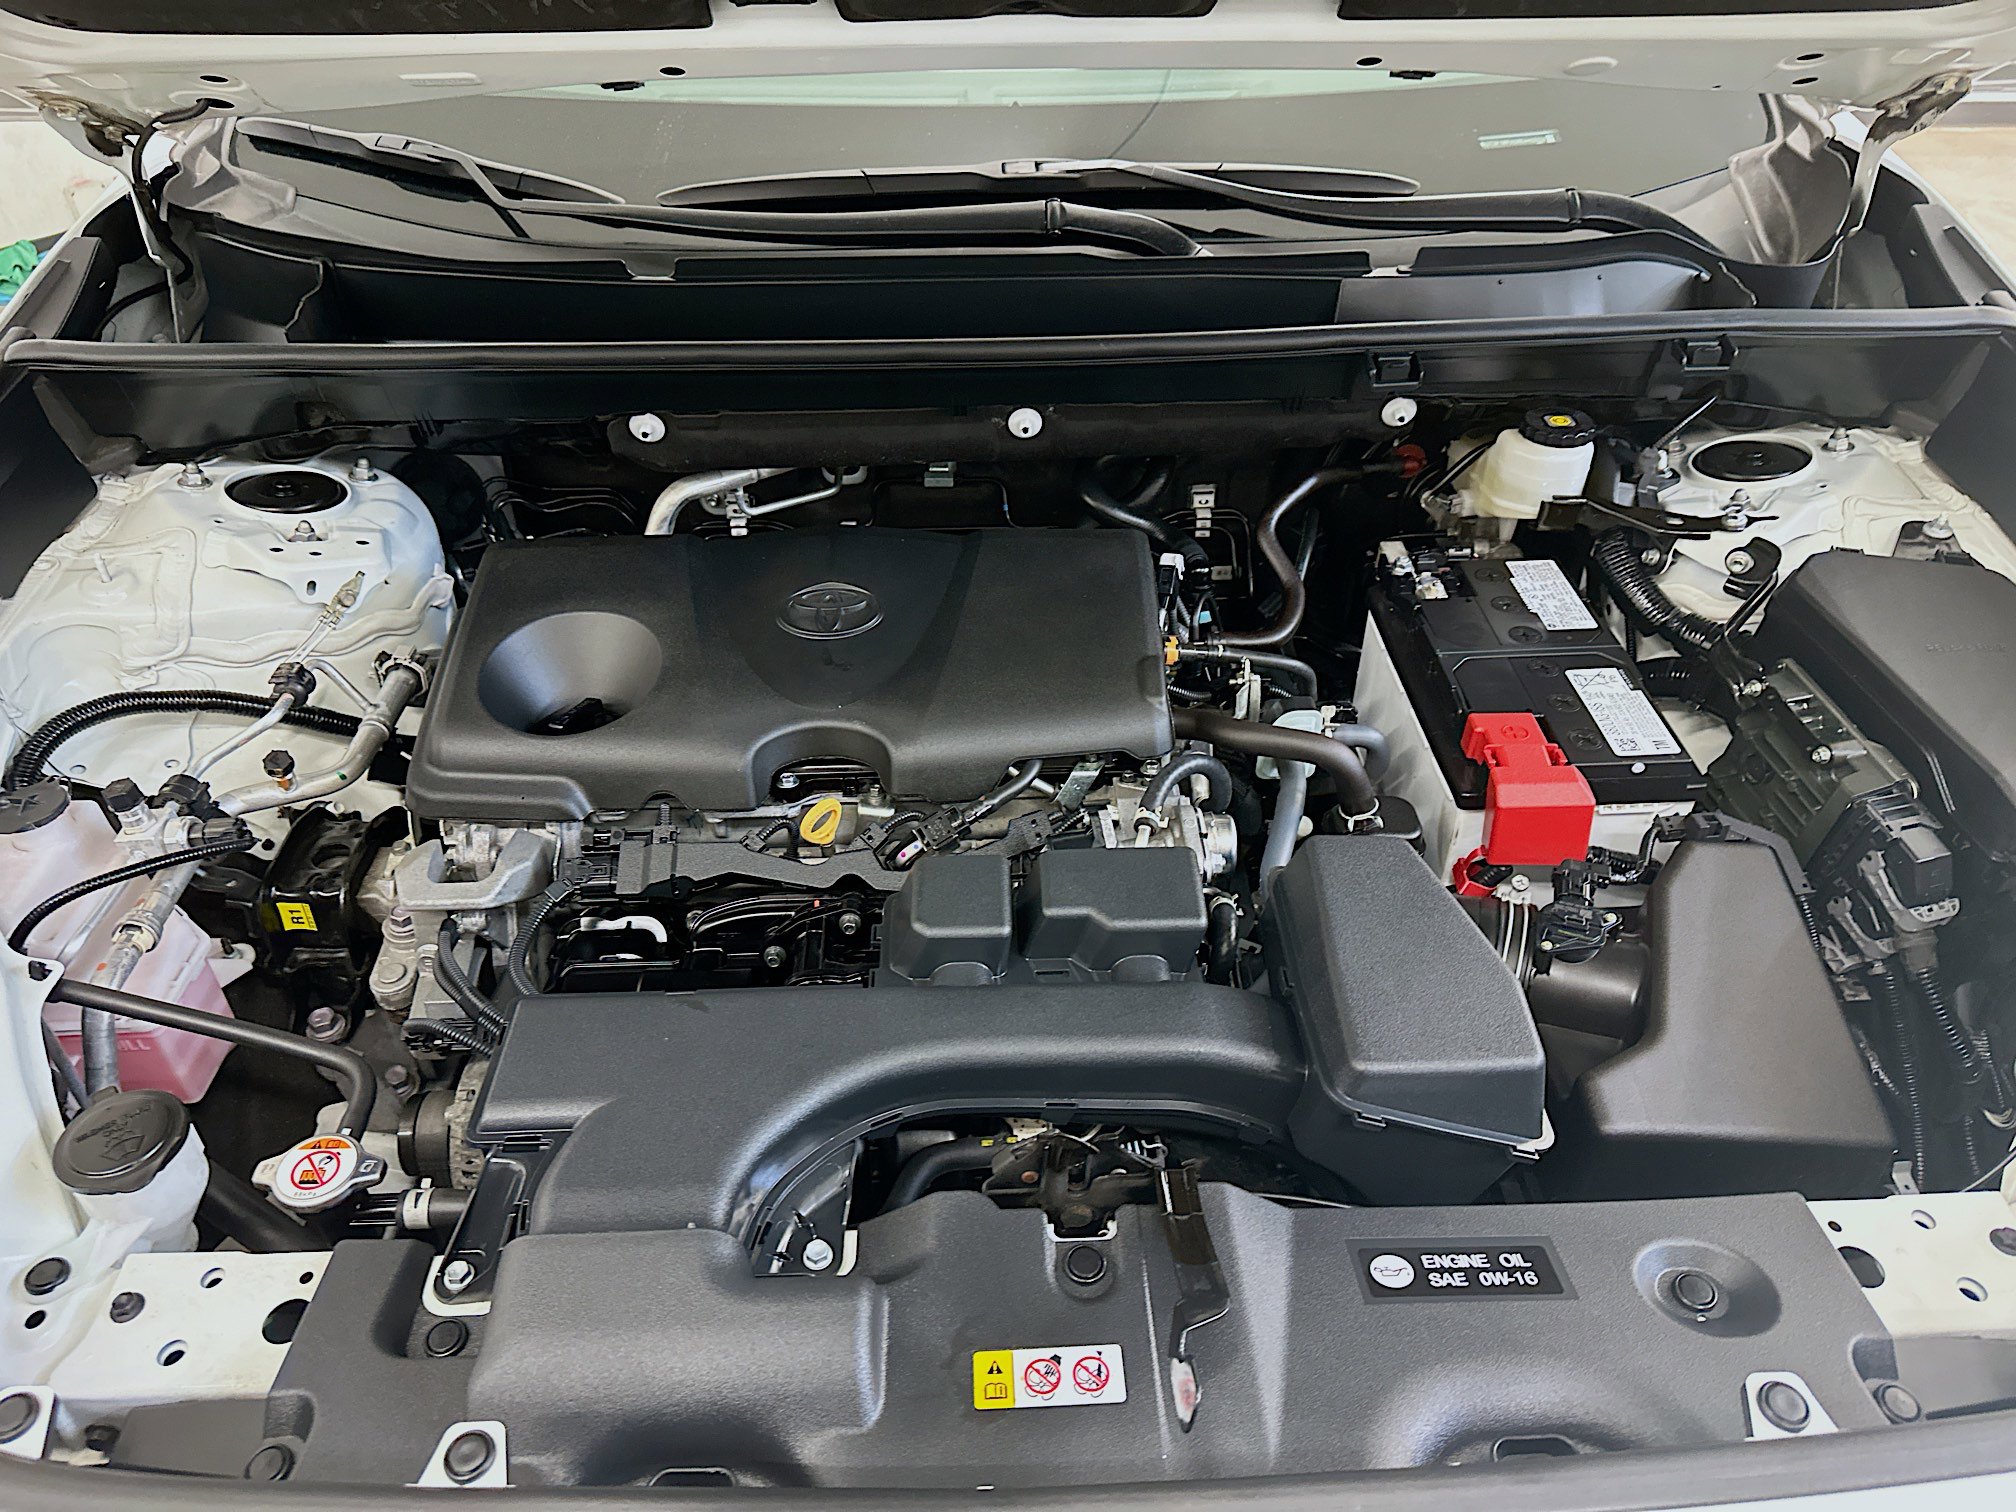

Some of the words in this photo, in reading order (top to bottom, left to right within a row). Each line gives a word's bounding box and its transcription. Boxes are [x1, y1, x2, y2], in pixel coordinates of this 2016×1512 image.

[288, 909, 305, 924] R1
[1420, 1254, 1491, 1269] ENGINE
[1498, 1253, 1532, 1268] OIL
[1427, 1272, 1470, 1287] SAE
[1478, 1271, 1539, 1287] 0W-16
